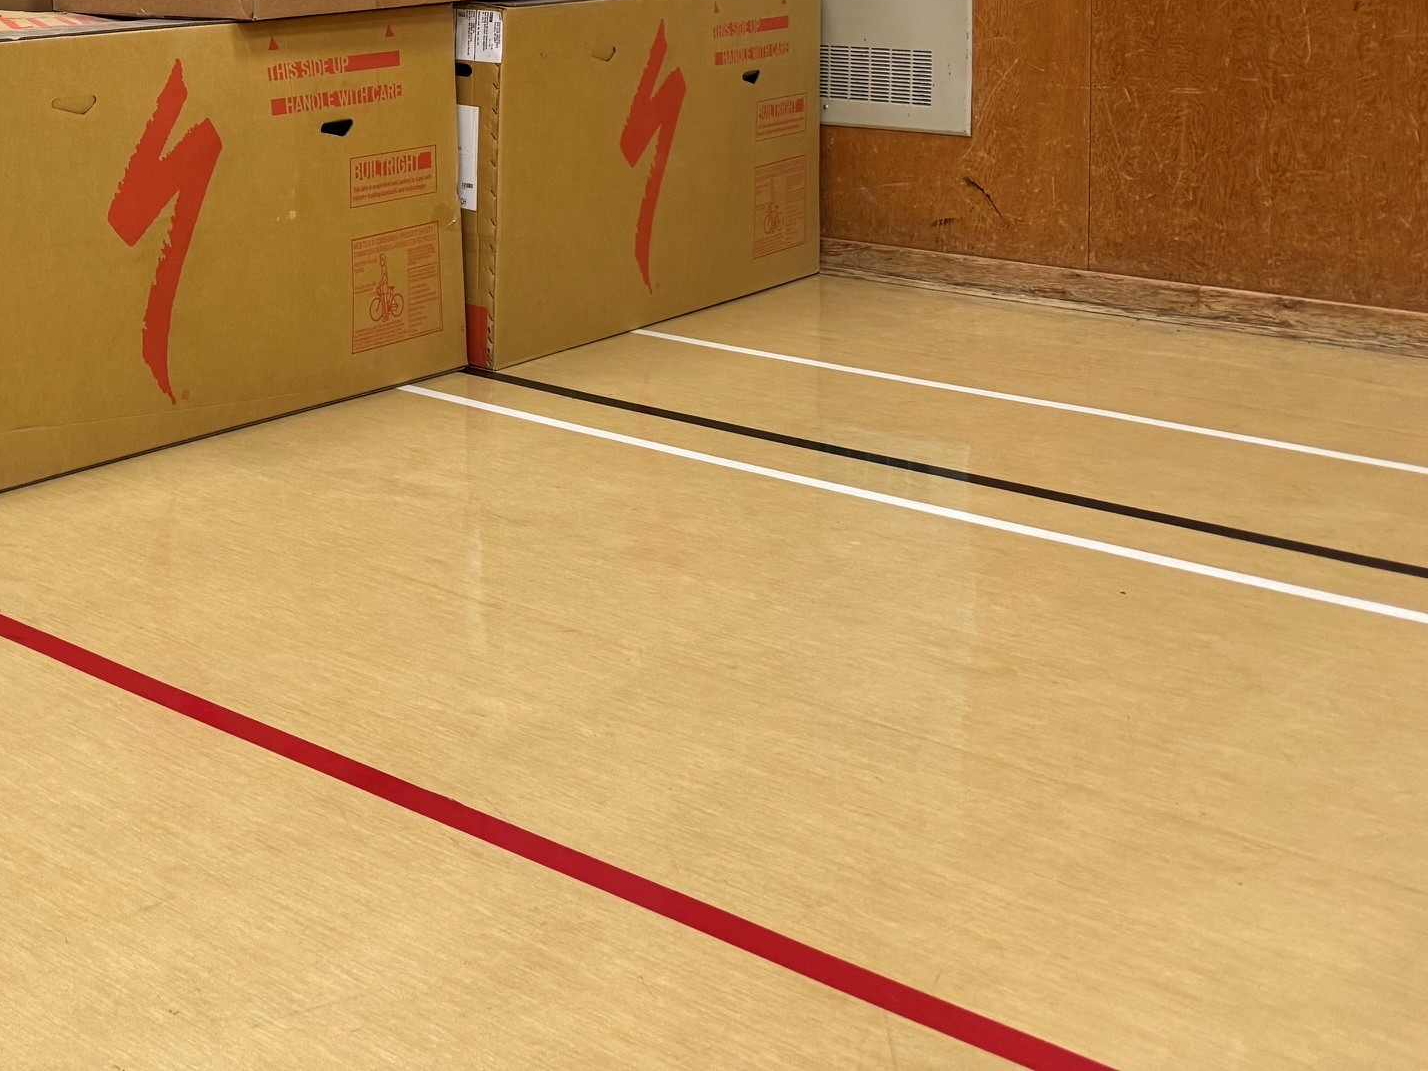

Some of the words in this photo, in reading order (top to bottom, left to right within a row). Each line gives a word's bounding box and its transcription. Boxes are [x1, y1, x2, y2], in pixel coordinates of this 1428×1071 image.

[713, 22, 731, 38] THIS
[732, 20, 750, 36] SIDE
[751, 19, 760, 34] UP
[268, 61, 298, 81] THIS
[301, 58, 330, 78] SIDE
[332, 56, 348, 74] UP
[723, 48, 752, 65] HANDLE
[285, 92, 336, 114] HANDLE
[338, 87, 368, 107] WITH
[372, 82, 402, 102] CARE
[354, 154, 419, 180] BUILTRIGHT
